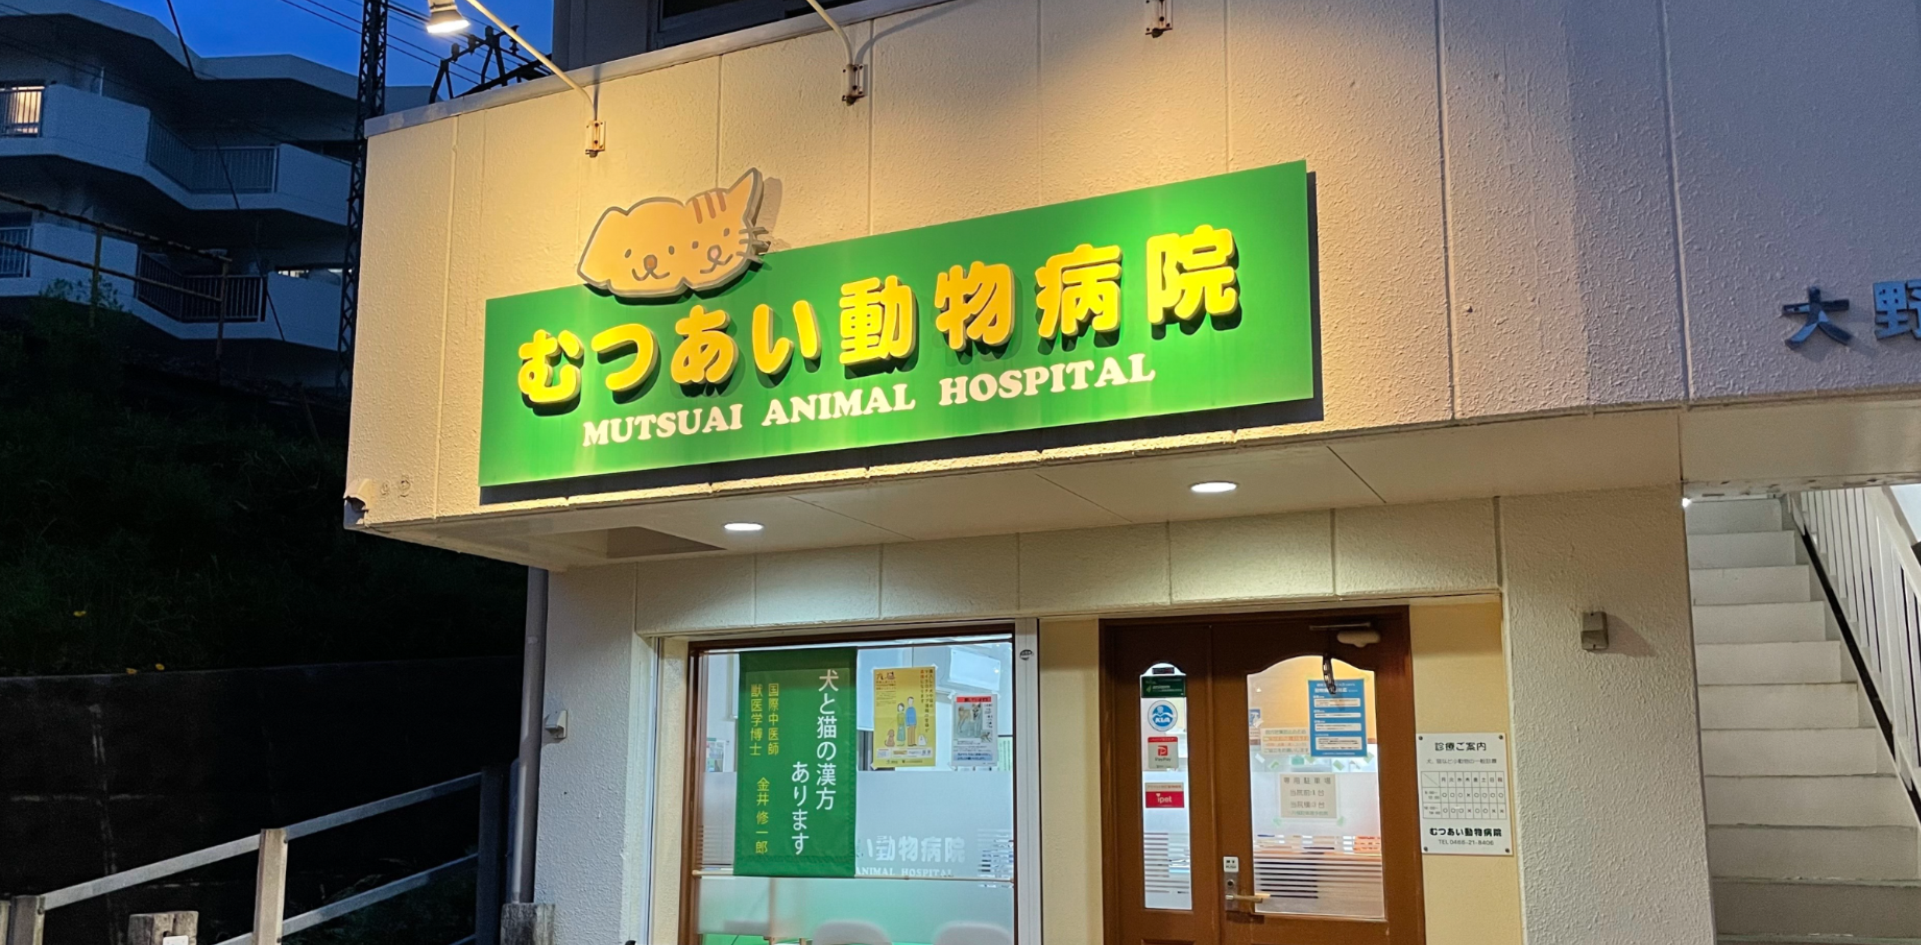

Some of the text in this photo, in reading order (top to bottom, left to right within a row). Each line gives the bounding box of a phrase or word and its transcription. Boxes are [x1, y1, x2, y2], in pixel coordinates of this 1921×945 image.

[518, 224, 1240, 407] むつあい動物病院
[581, 353, 1156, 448] MUTSUAI ANIMAL HOSPITAL
[750, 684, 763, 756] 獣医学博士
[768, 683, 779, 756] 国際中医師
[815, 669, 840, 811] 犬と猫の漢方
[791, 761, 810, 855] あります
[1429, 827, 1502, 837] むつあい動物病院
